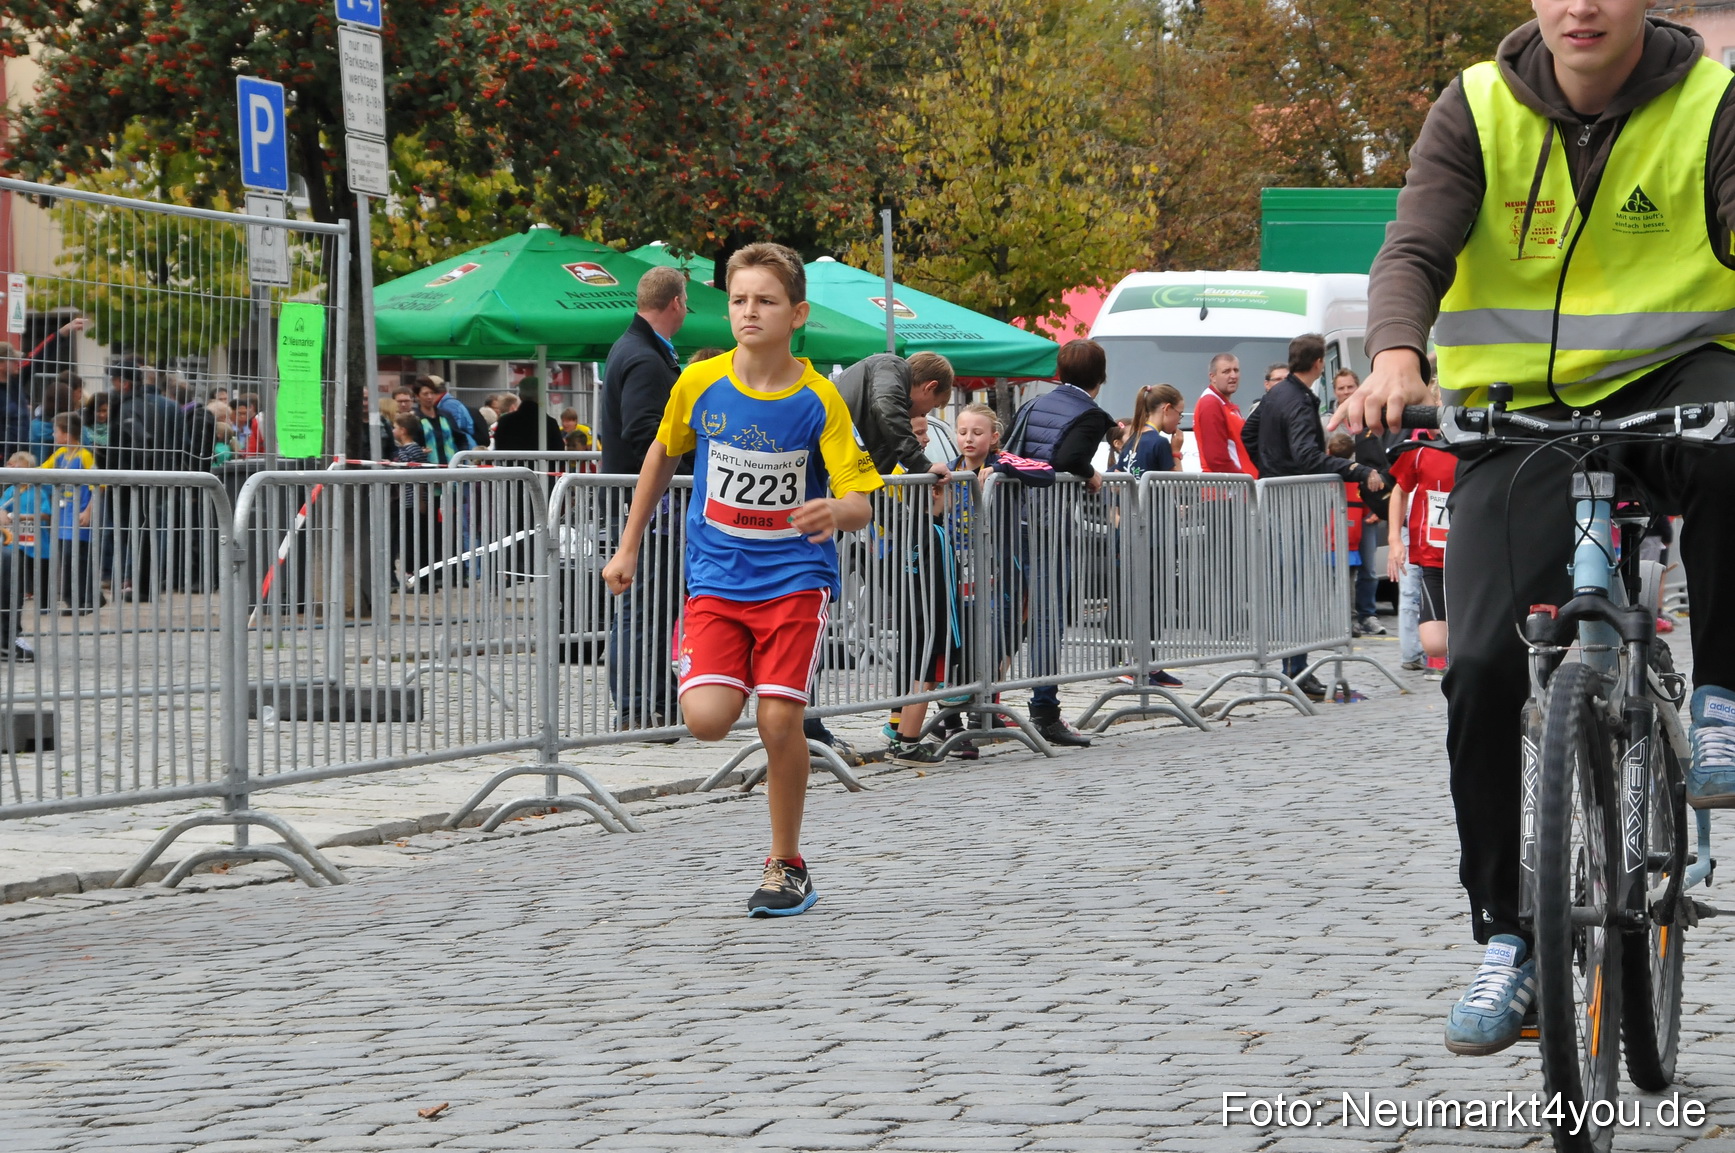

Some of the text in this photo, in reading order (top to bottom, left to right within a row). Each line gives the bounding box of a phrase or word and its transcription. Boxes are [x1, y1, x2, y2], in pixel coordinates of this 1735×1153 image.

[349, 40, 373, 54] nur mit
[344, 52, 379, 72] Parkschein
[349, 73, 378, 91] werktags
[249, 93, 276, 173] P
[1505, 200, 1555, 208] NEUMKTER
[1615, 221, 1640, 229] einfach
[1204, 288, 1264, 296] Europcar
[1619, 411, 1658, 430] STRIKE
[711, 450, 792, 471] PARTL Neumarkt
[858, 455, 873, 468] PAR
[859, 464, 877, 475] Neum
[717, 466, 797, 506] 7223
[1430, 495, 1446, 503] PART
[733, 512, 773, 528] Jonas
[1627, 742, 1645, 860] AXEL
